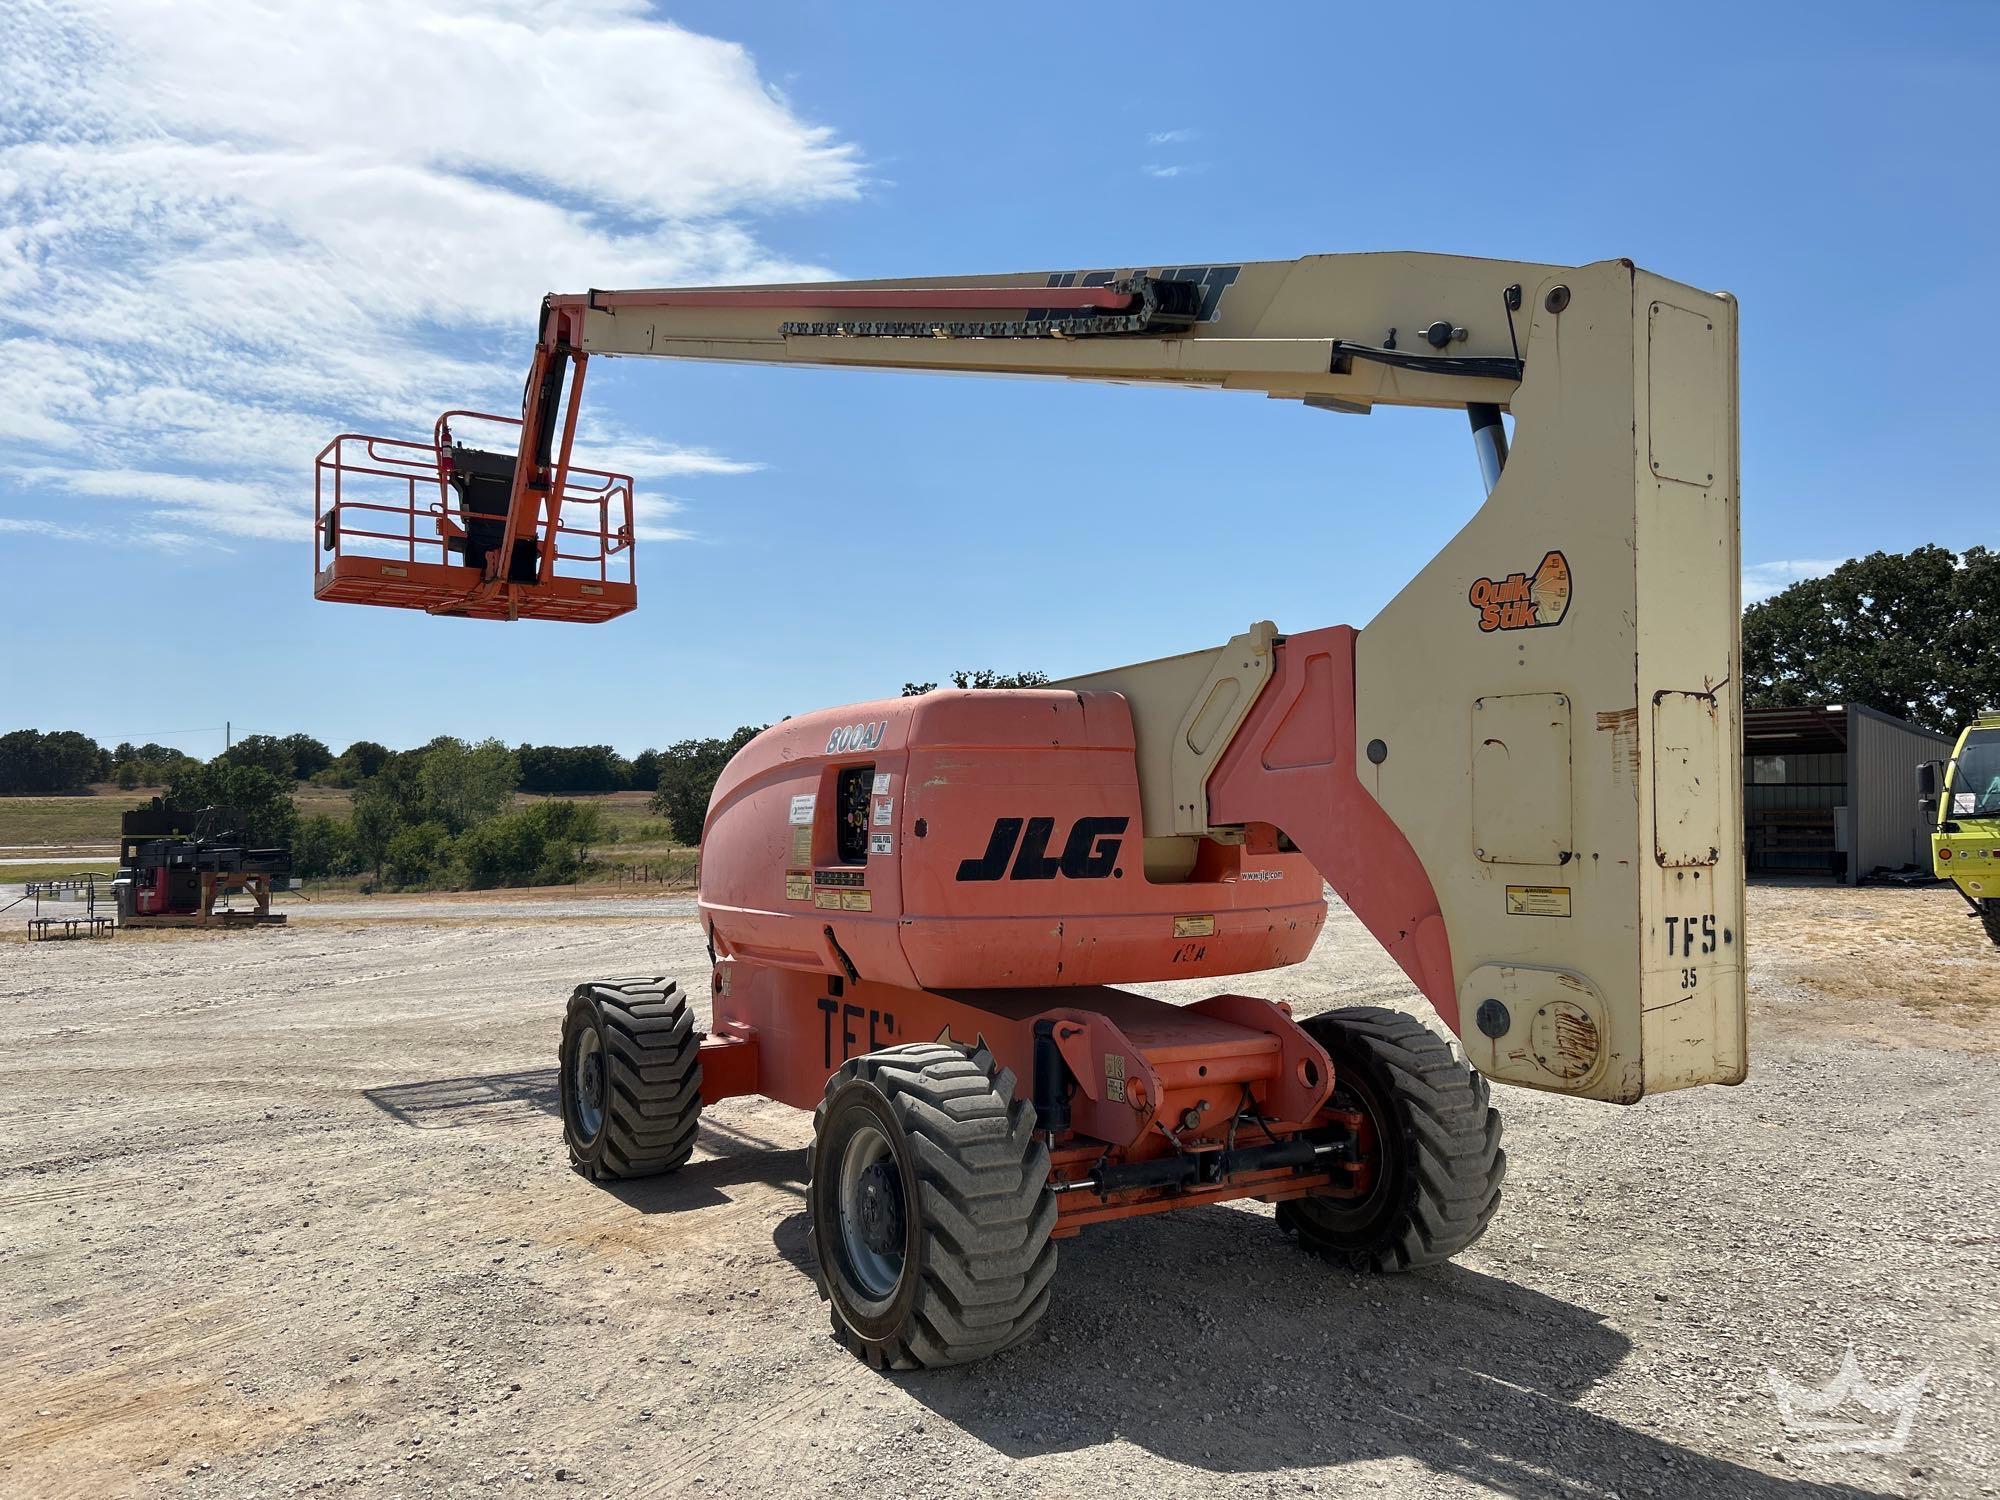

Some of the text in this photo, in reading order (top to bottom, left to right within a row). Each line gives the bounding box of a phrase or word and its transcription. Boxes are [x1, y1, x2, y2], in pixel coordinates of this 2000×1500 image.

[1470, 574, 1534, 609] Quik
[1479, 600, 1540, 631] Stik
[826, 720, 888, 754] 800AJ
[1241, 870, 1283, 882] www.jlg.com
[1681, 966, 1697, 989] 35
